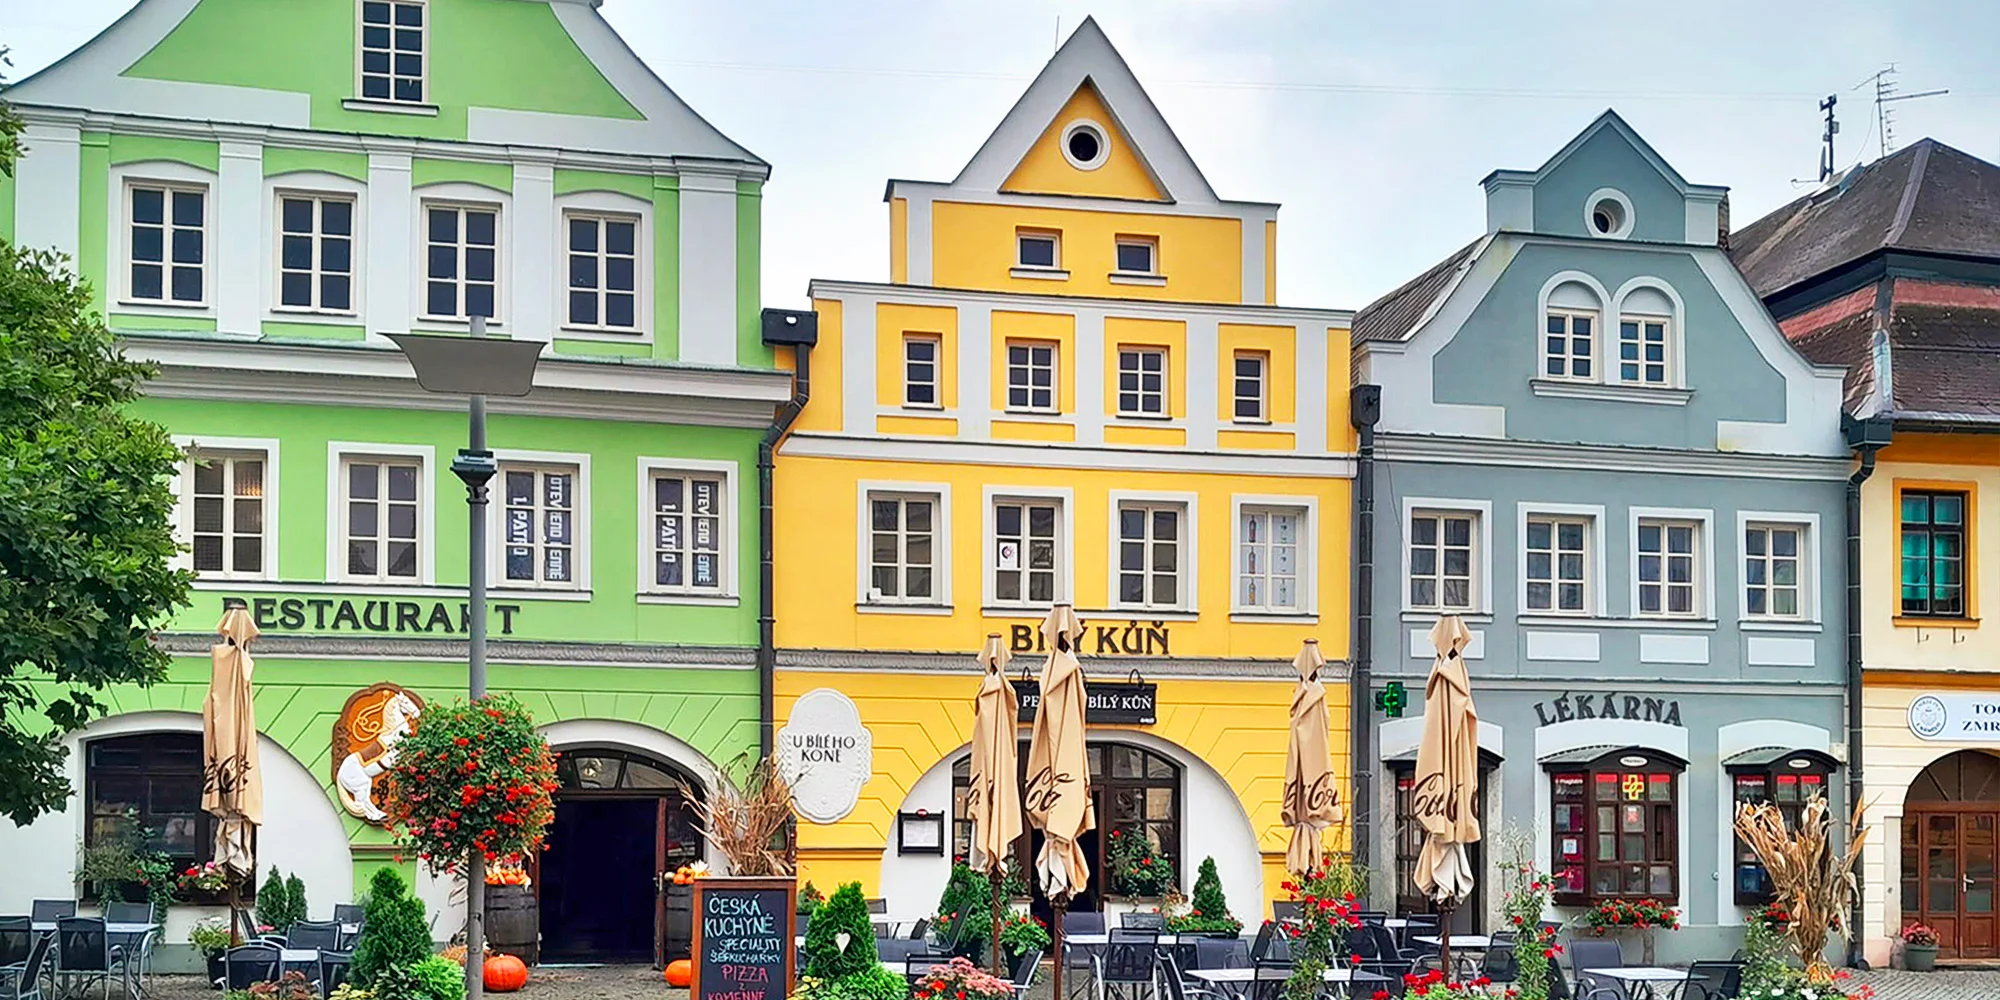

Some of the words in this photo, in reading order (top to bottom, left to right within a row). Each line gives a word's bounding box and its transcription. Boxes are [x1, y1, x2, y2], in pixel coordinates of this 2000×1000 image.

[1096, 620, 1169, 655] KŮŇ
[1088, 694, 1121, 709] BÍLÝ
[1534, 690, 1683, 727] LÉKÁRNA
[793, 735, 803, 749] U
[709, 892, 761, 916] ČESKÁ
[721, 964, 769, 983] PIZZA
